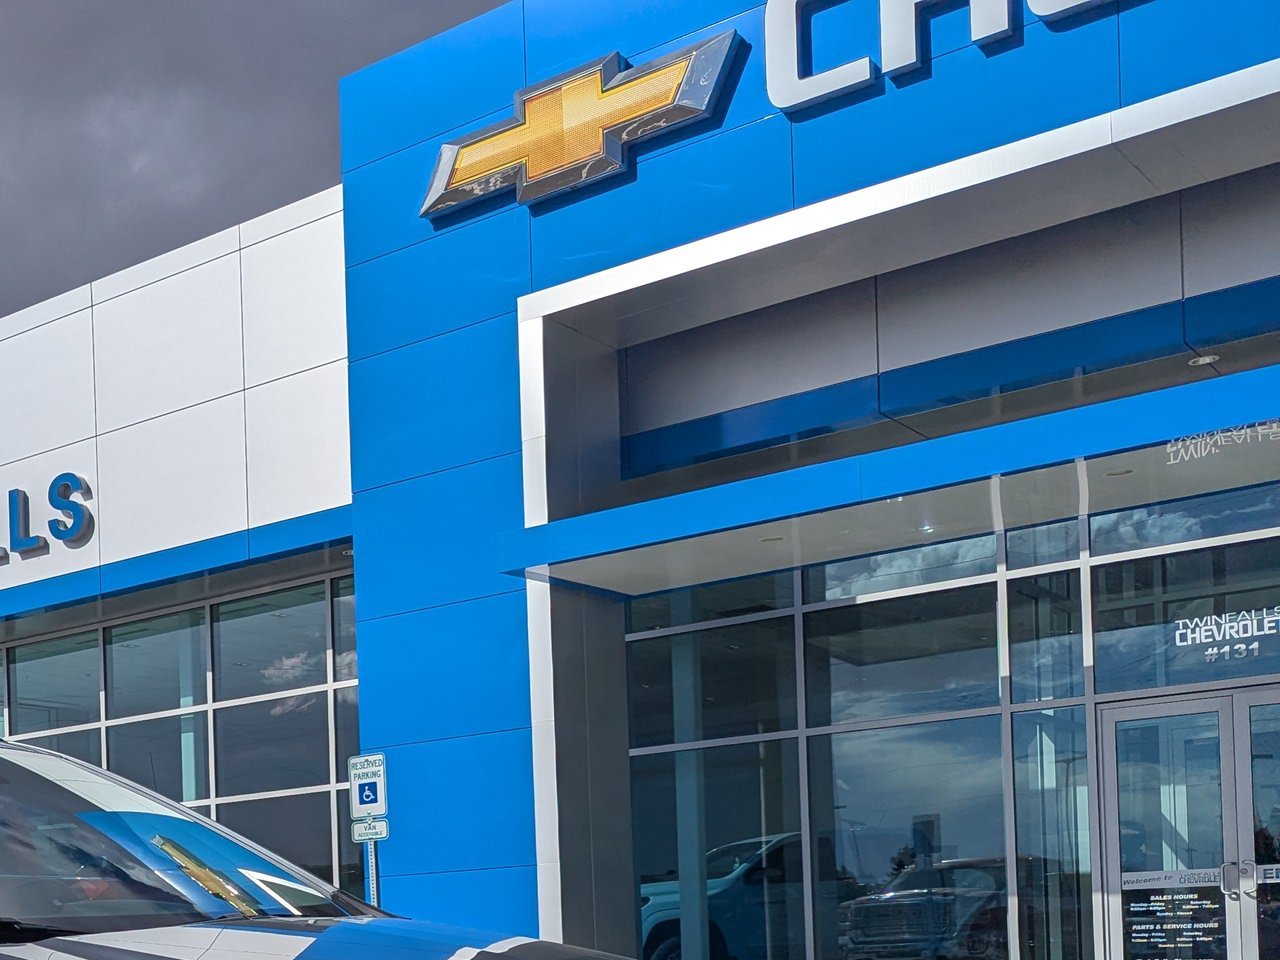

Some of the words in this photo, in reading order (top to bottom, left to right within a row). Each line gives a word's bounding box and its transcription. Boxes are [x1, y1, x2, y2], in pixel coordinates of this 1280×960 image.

[1204, 641, 1259, 663] #131
[351, 758, 383, 770] RESERVED
[353, 770, 381, 781] PARKING
[1123, 876, 1161, 886] Welcome
